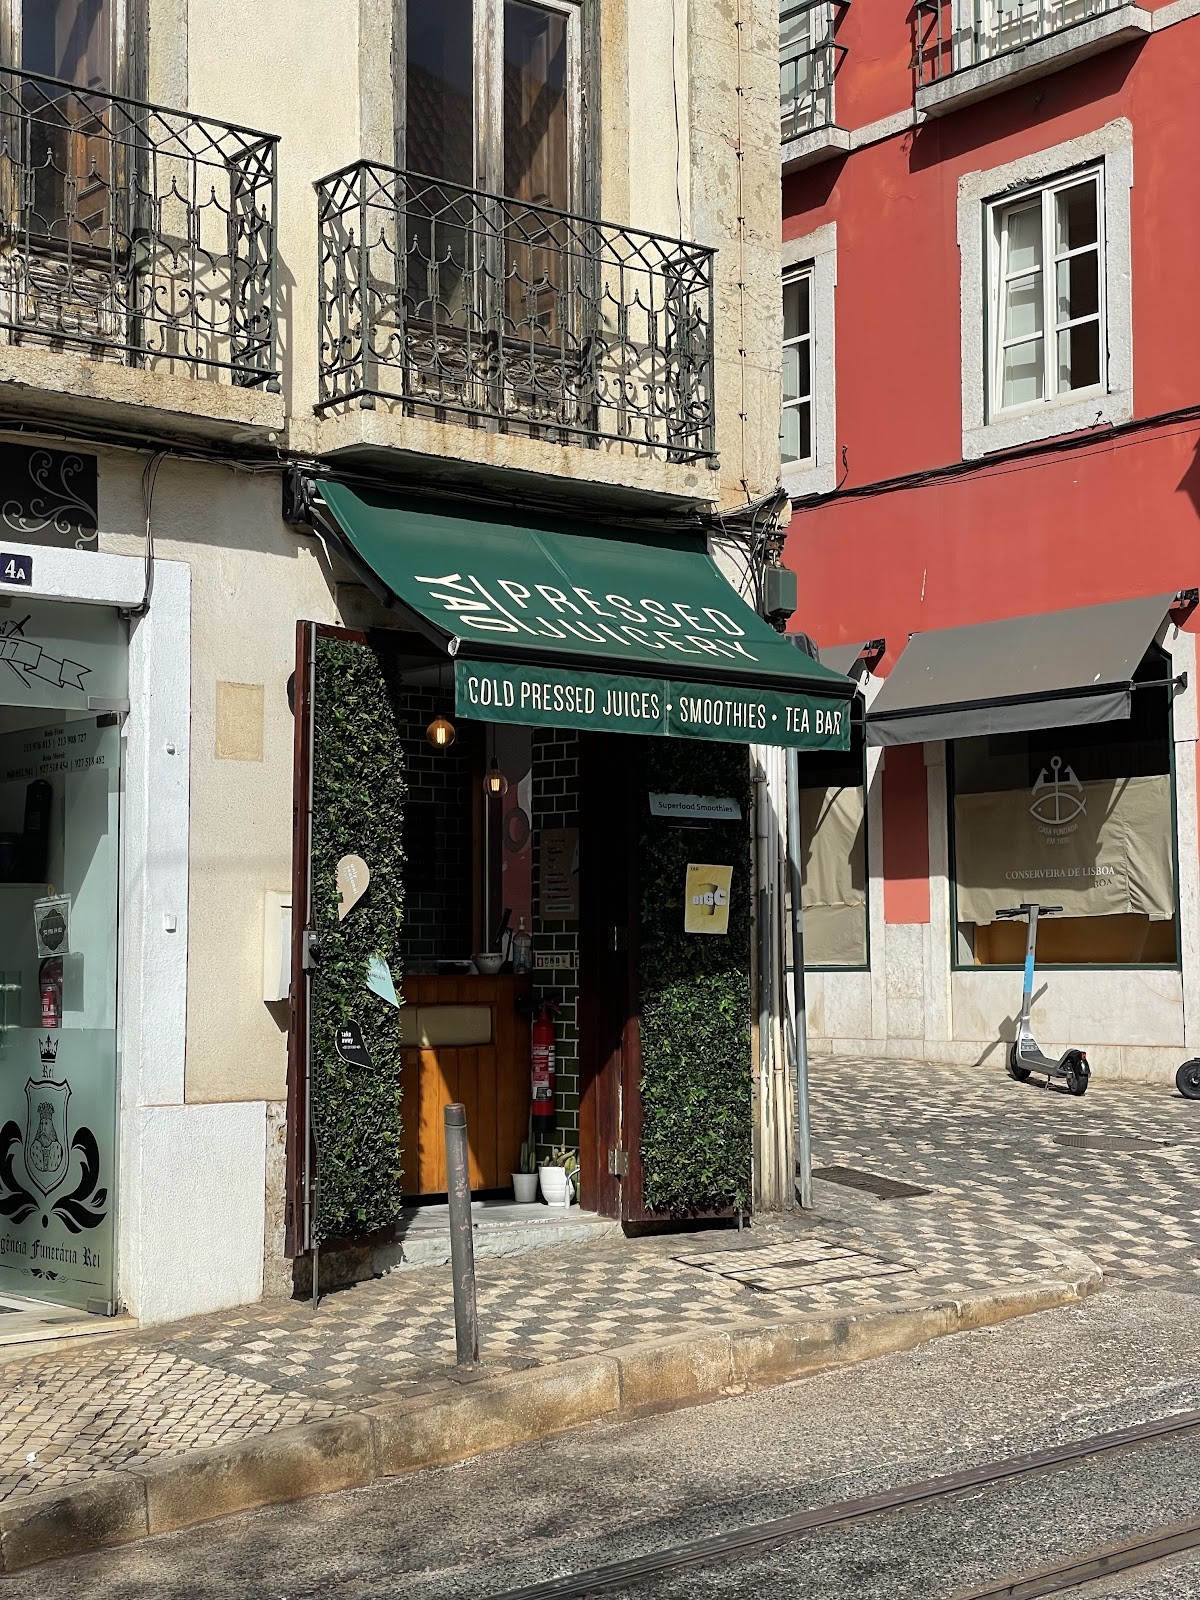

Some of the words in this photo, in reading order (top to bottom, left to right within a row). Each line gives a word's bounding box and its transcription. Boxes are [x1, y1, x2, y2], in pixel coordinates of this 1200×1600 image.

[5, 559, 26, 580] 4A
[497, 579, 745, 636] PRESSED
[535, 616, 760, 661] JUICERY
[468, 676, 514, 707] COLD
[521, 682, 595, 714] PRESSED
[602, 690, 660, 719] JUICES
[679, 697, 766, 730] SMOOTHIES
[786, 706, 810, 734] TEA
[816, 710, 842, 735] BAR
[75, 758, 84, 768] 927
[85, 757, 94, 767] 518
[95, 755, 105, 765] 482
[658, 801, 695, 811] Superfood
[696, 804, 733, 813] Smoothies
[1038, 826, 1052, 835] CASA
[1053, 823, 1079, 835] FUNDADA
[350, 863, 358, 878] only
[1005, 869, 1066, 880] CONSERVEIRA
[1067, 867, 1080, 877] DE
[1082, 866, 1115, 876] LISBOA
[42, 1064, 55, 1079] Rei
[30, 1239, 77, 1264] Funerária
[83, 1246, 101, 1268] Rei
